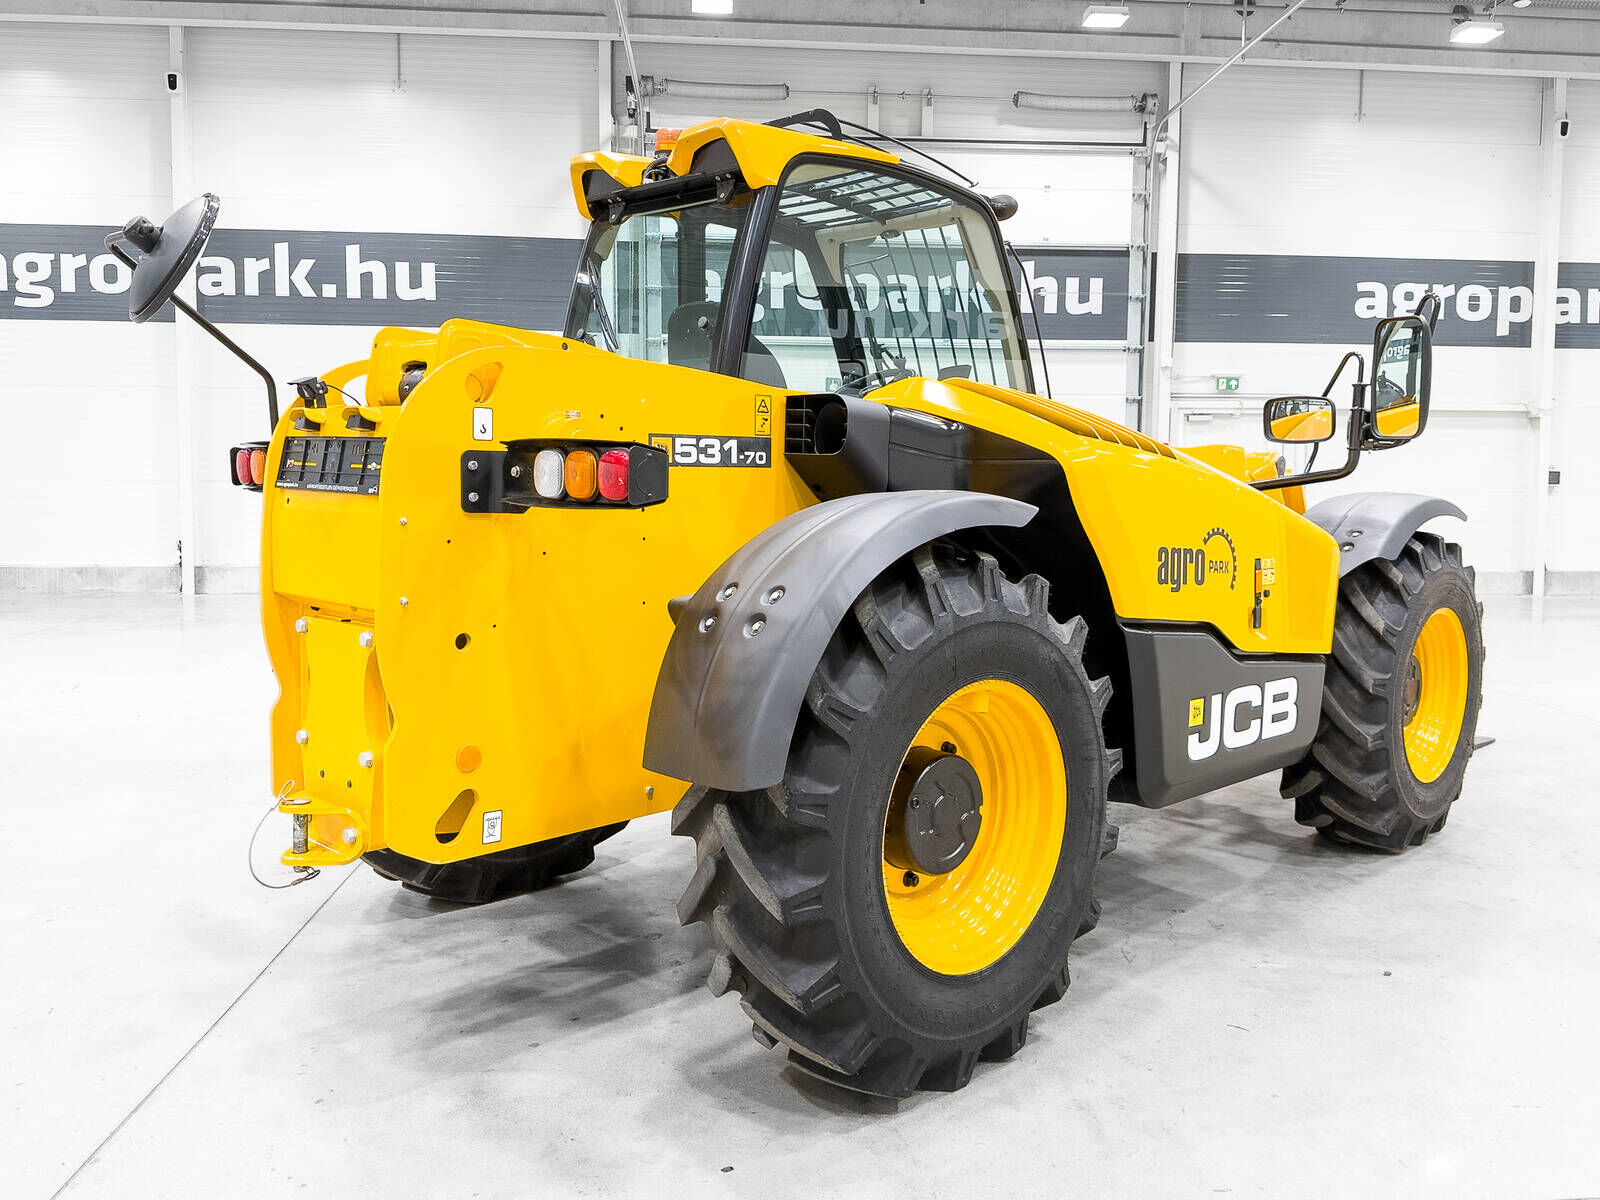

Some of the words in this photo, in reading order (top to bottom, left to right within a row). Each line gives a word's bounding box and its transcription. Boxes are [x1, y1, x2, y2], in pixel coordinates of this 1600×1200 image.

[0, 242, 437, 308] groark.hu
[674, 437, 767, 464] 531-70
[1157, 546, 1205, 592] agro
[1208, 560, 1230, 573] PARK
[1187, 676, 1298, 761] JCB
